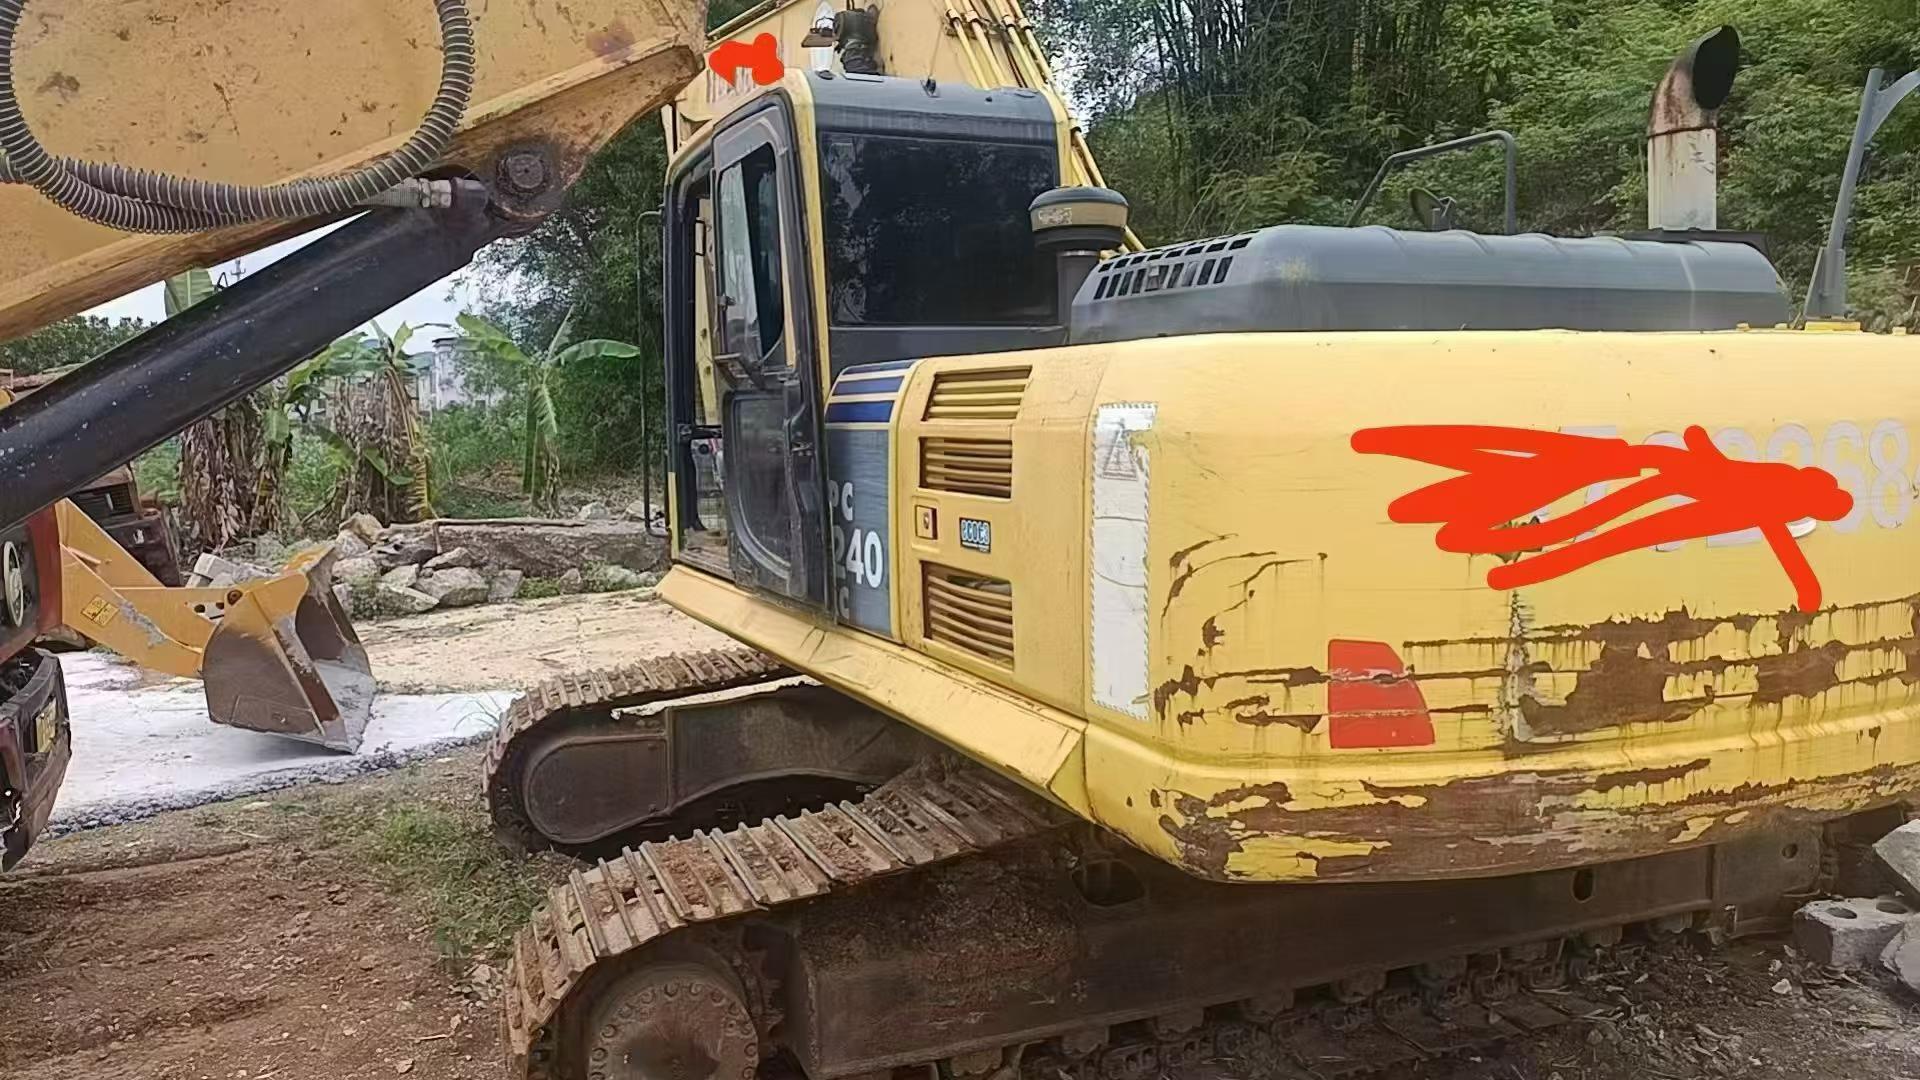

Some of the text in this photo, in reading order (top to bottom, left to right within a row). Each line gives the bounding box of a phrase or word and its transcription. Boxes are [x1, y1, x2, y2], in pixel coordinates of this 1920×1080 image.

[828, 480, 853, 521] PC
[833, 525, 883, 588] 240
[837, 586, 849, 619] C
